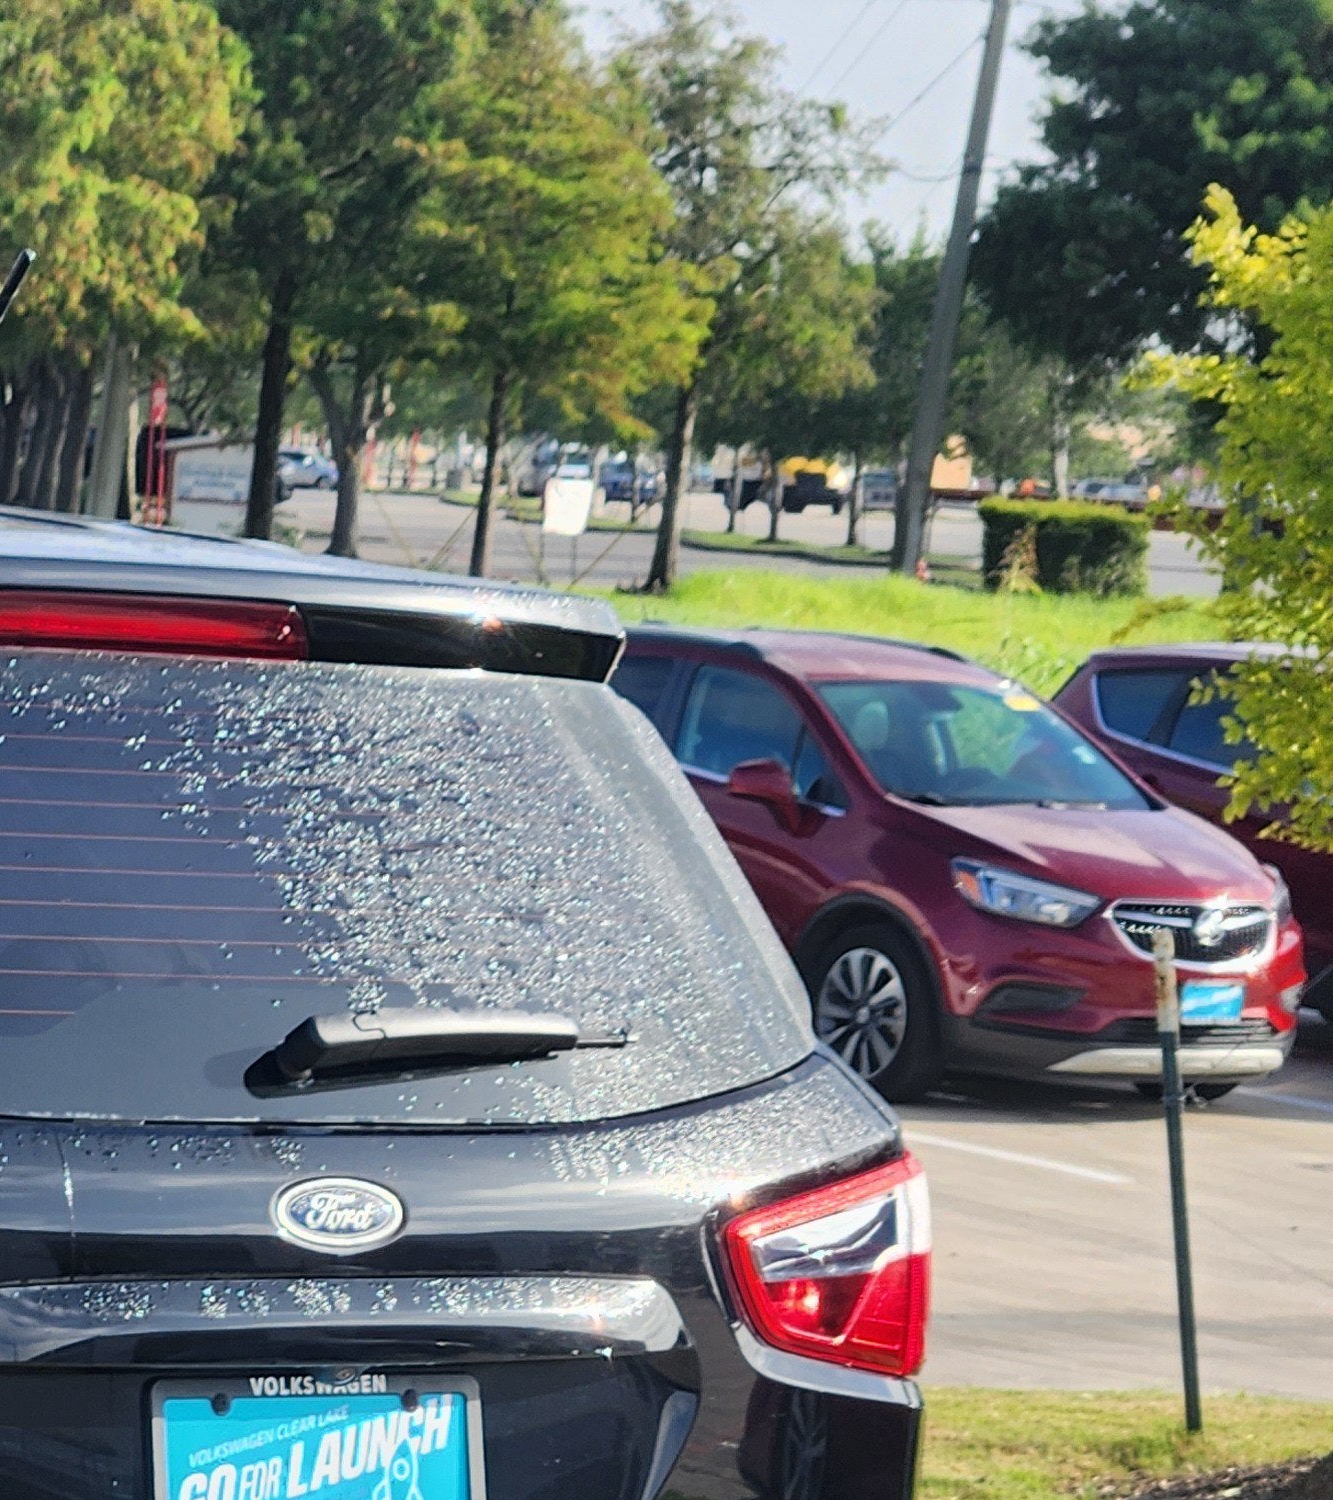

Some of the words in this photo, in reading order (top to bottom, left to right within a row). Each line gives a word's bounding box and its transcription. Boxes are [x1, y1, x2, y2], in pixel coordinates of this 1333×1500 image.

[305, 1193, 376, 1230] Ford
[189, 1428, 274, 1467] VOLKSWAGEN
[276, 1414, 316, 1440] CLEAR
[317, 1404, 351, 1428] LAKE
[286, 1393, 453, 1499] LAUNCH
